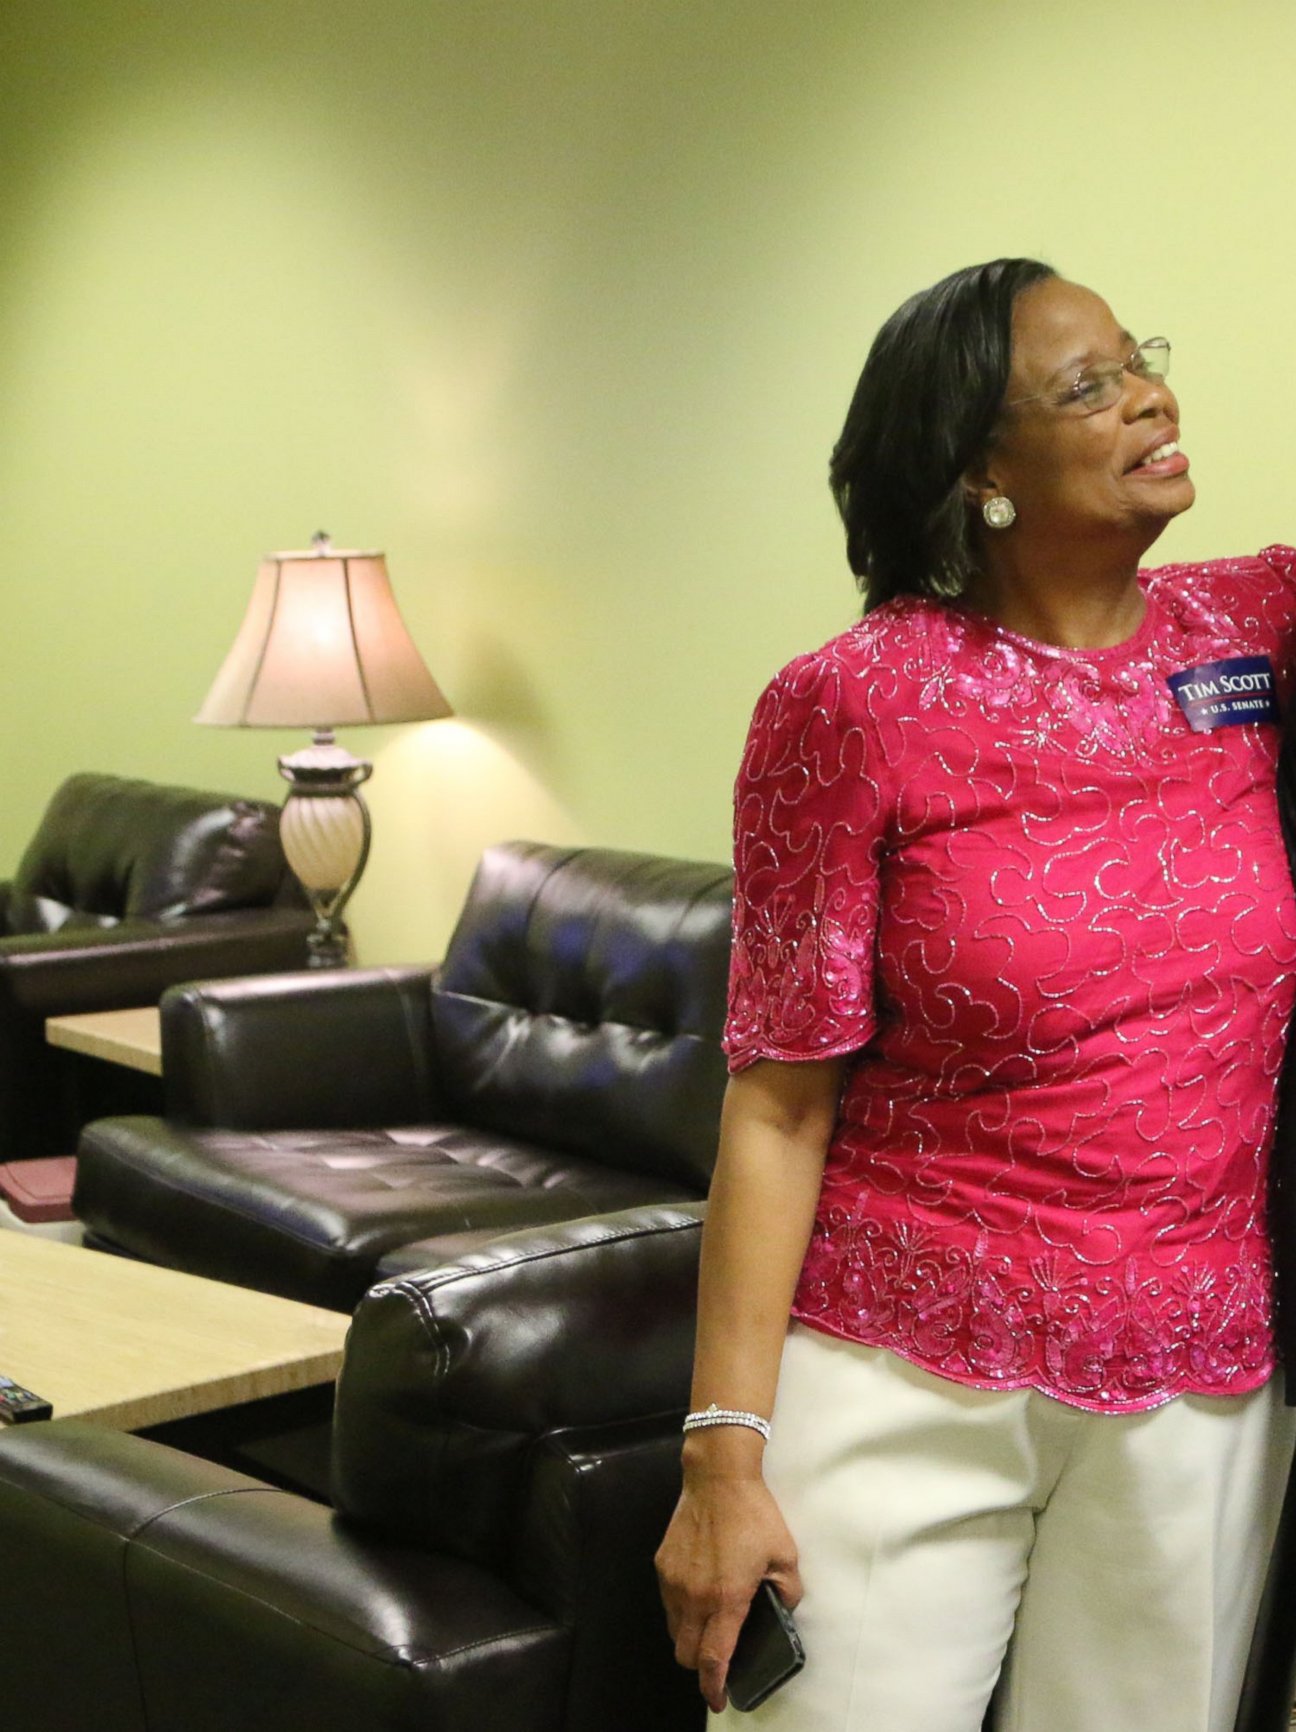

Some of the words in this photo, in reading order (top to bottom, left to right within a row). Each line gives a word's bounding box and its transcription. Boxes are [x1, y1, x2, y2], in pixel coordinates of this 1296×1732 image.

[1178, 680, 1220, 701] TIM
[1220, 673, 1271, 693] SCOTT
[1210, 704, 1231, 714] U.S.
[1232, 699, 1264, 711] SENATE
